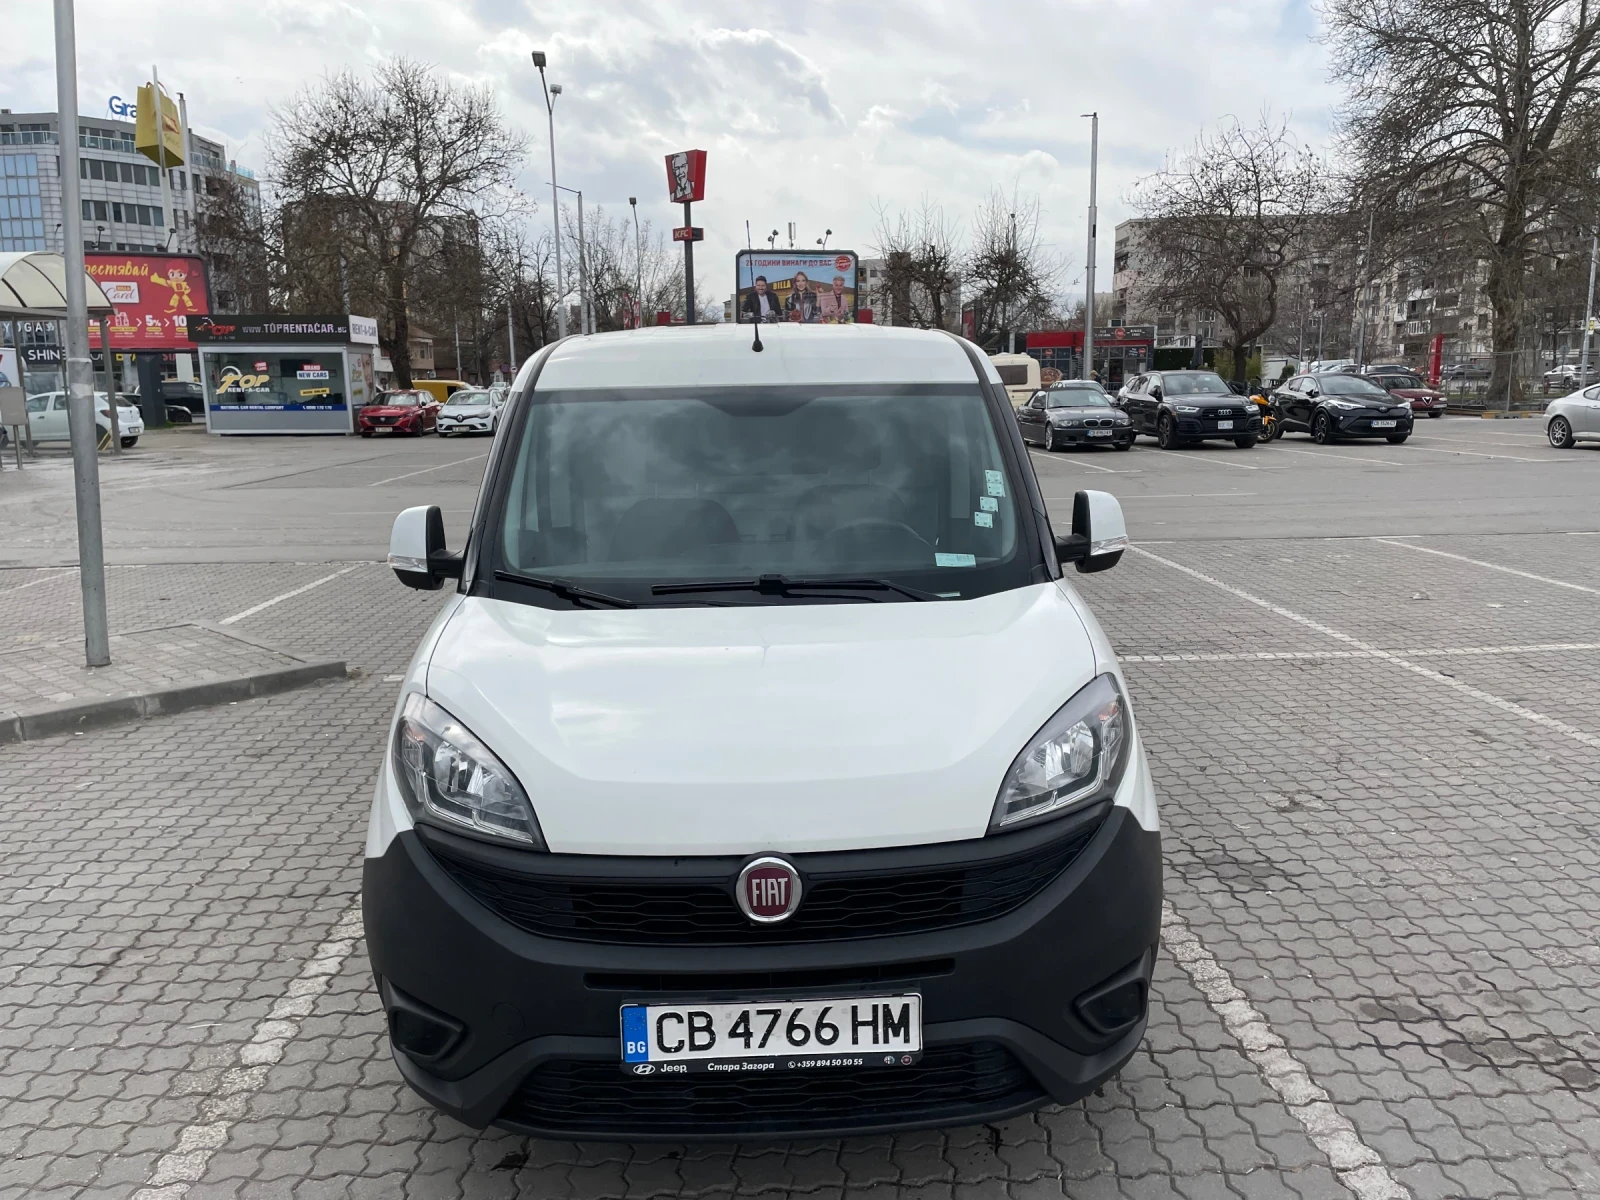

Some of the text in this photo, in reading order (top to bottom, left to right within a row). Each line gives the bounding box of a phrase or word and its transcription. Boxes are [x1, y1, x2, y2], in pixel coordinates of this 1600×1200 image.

[675, 229, 688, 238] KFC
[773, 280, 791, 290] BILLA
[106, 287, 136, 300] Card
[145, 315, 162, 326] 5%
[352, 323, 377, 337] RENT-A-CAR
[215, 374, 270, 395] TOP
[752, 878, 788, 906] FIAT
[656, 1003, 910, 1053] CB 4766 HM
[627, 1041, 646, 1054] BG
[661, 1064, 687, 1073] Jeep
[707, 1062, 775, 1072] Стара Загора
